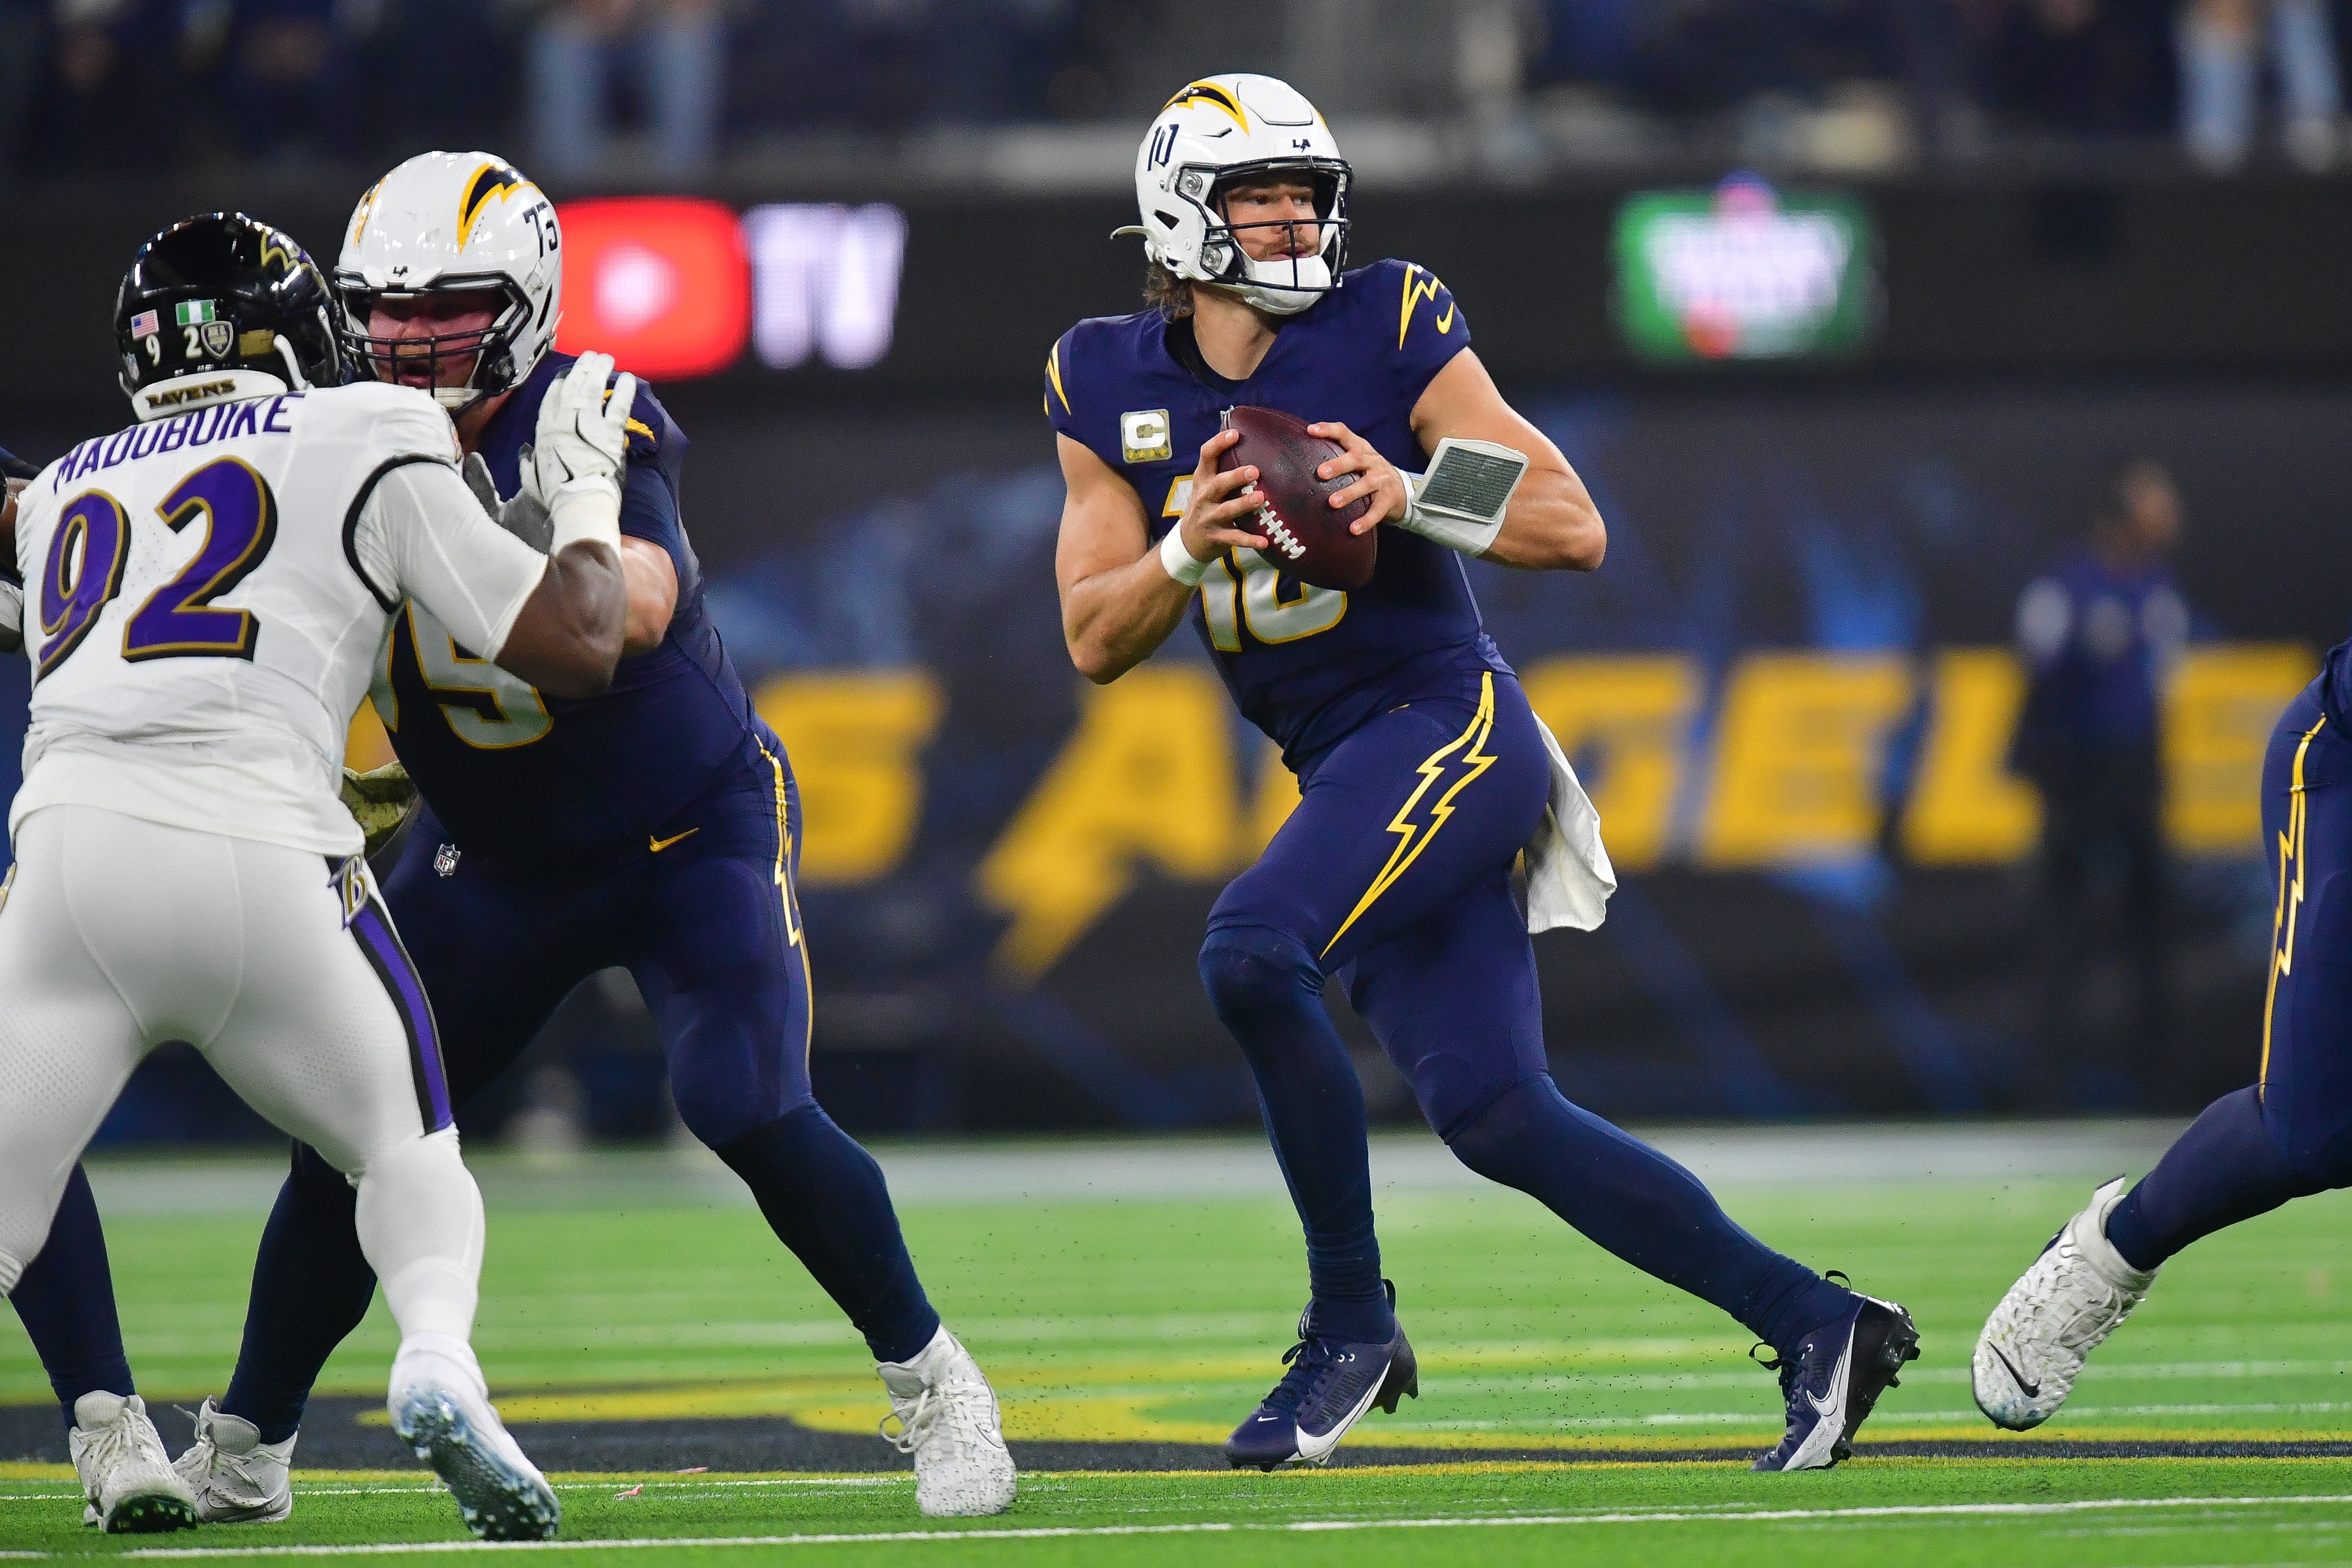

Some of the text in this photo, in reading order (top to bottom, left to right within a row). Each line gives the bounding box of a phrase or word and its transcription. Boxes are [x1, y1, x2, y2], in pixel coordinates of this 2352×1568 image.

[1147, 124, 1179, 172] 10
[1292, 139, 1310, 153] LA
[522, 200, 558, 259] 75
[145, 378, 236, 409] RAVENS
[54, 391, 305, 495] MADUBUIKE
[1125, 413, 1166, 449] C
[34, 455, 277, 687] 92
[367, 598, 554, 749] 5
